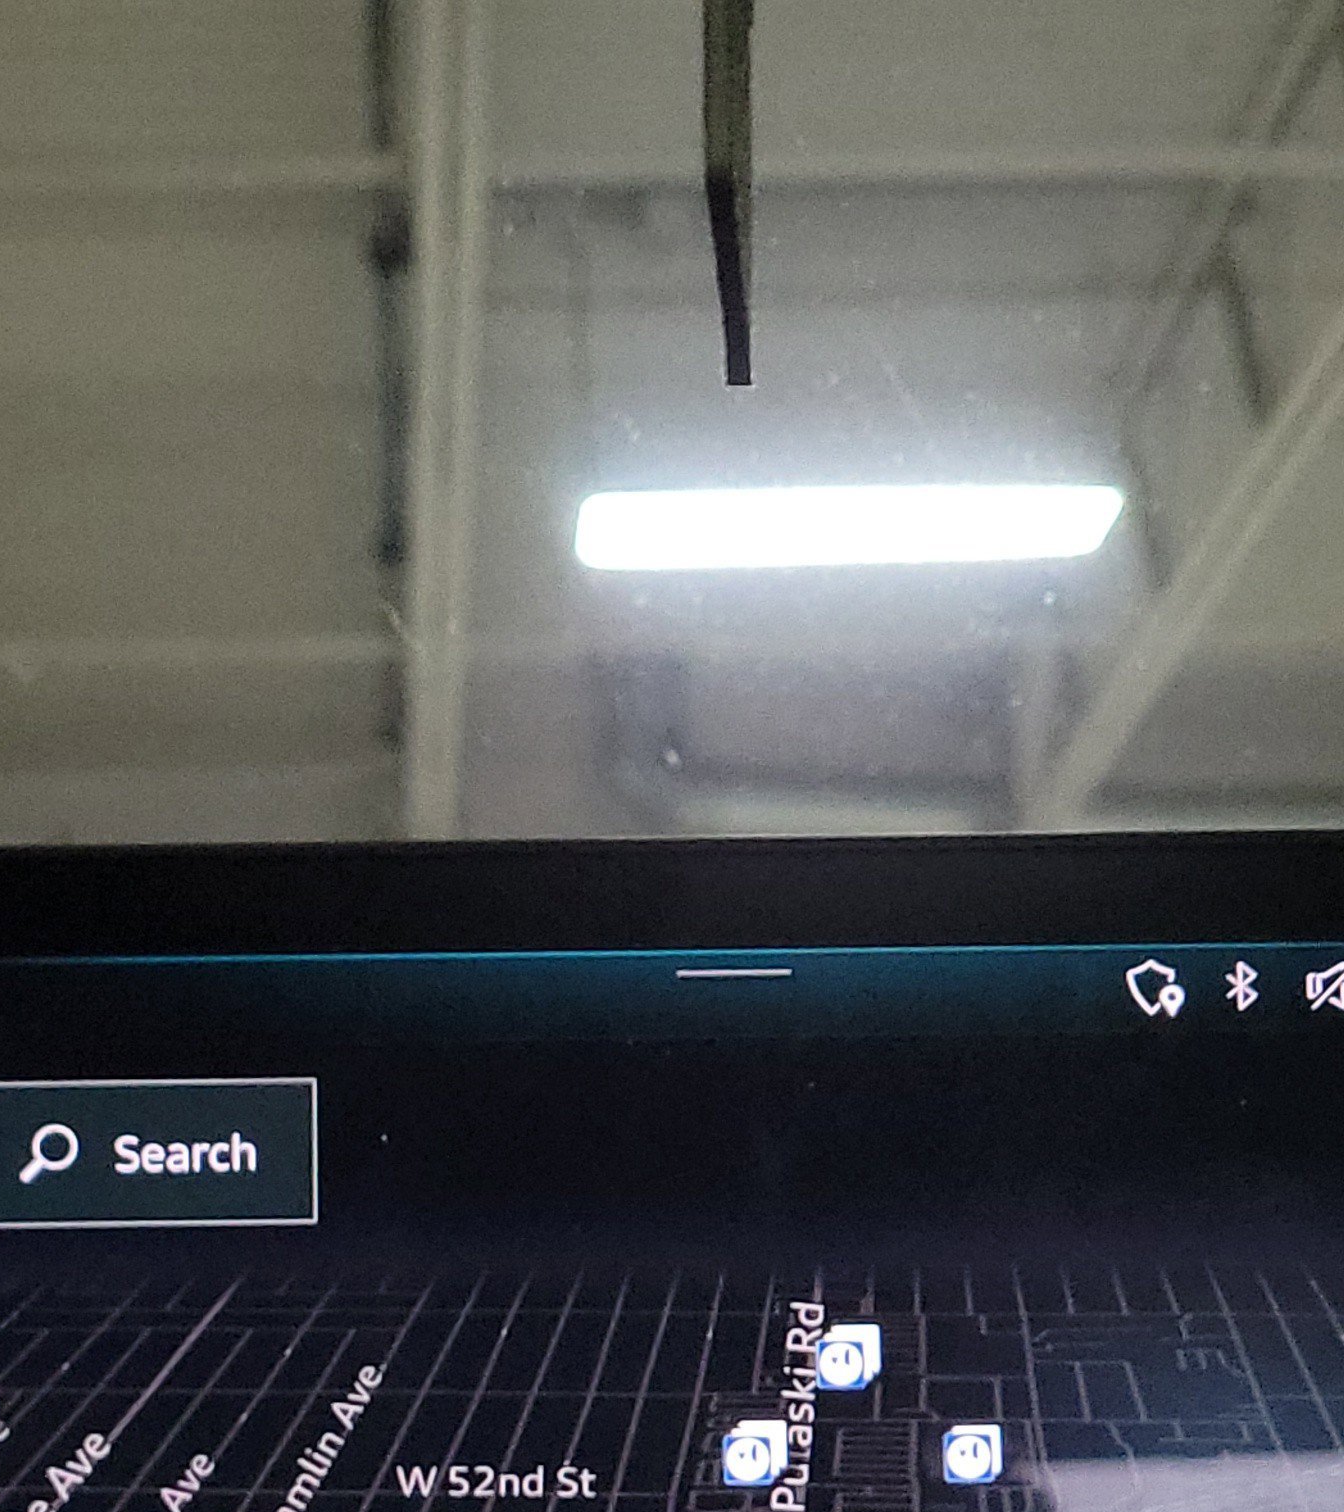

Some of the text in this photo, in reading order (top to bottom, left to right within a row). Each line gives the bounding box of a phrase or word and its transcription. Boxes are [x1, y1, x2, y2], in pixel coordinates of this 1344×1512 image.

[113, 1132, 257, 1174] Search
[786, 1301, 825, 1353] Rd
[331, 1364, 385, 1431] Ave
[44, 1432, 112, 1504] Ave
[395, 1464, 597, 1499] W 52nd St
